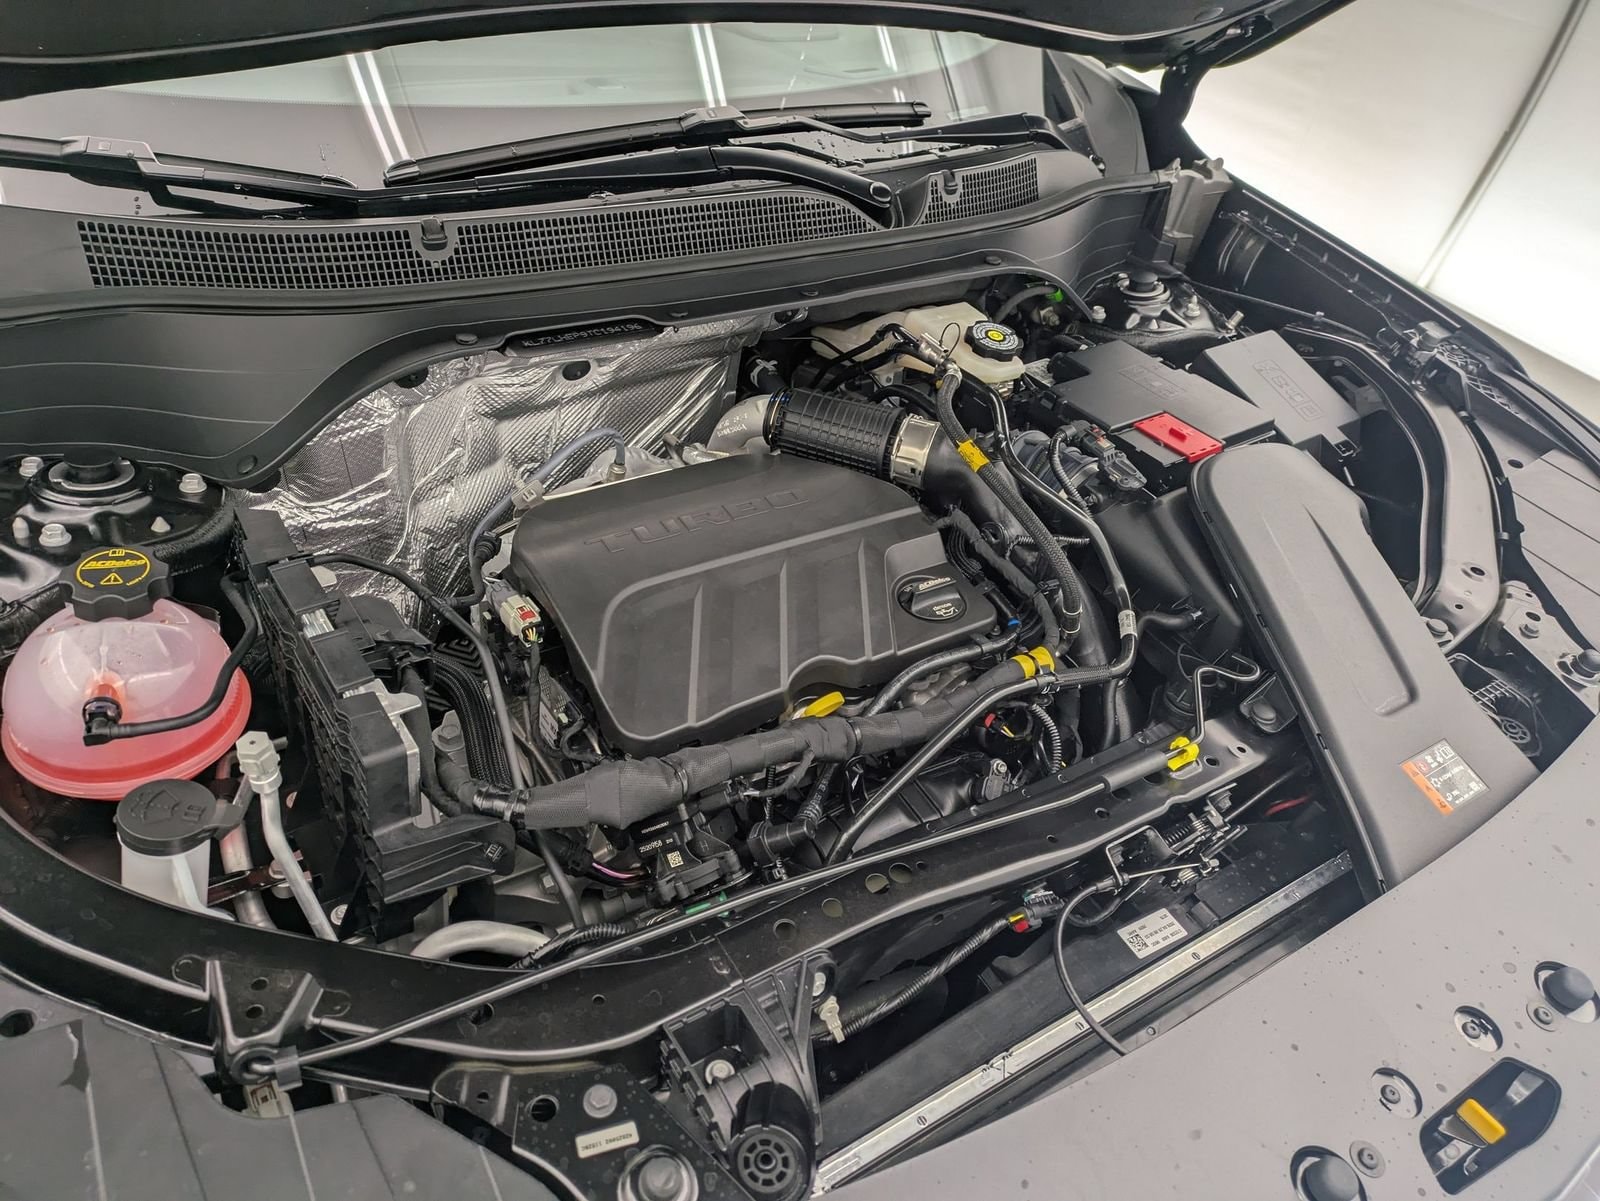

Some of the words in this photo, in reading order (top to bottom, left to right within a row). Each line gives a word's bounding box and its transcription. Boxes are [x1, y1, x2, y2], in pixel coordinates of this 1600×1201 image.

[522, 323, 642, 347] KL77LHEP9TC194196
[584, 489, 808, 553] TURBO
[83, 559, 146, 569] ACDelco
